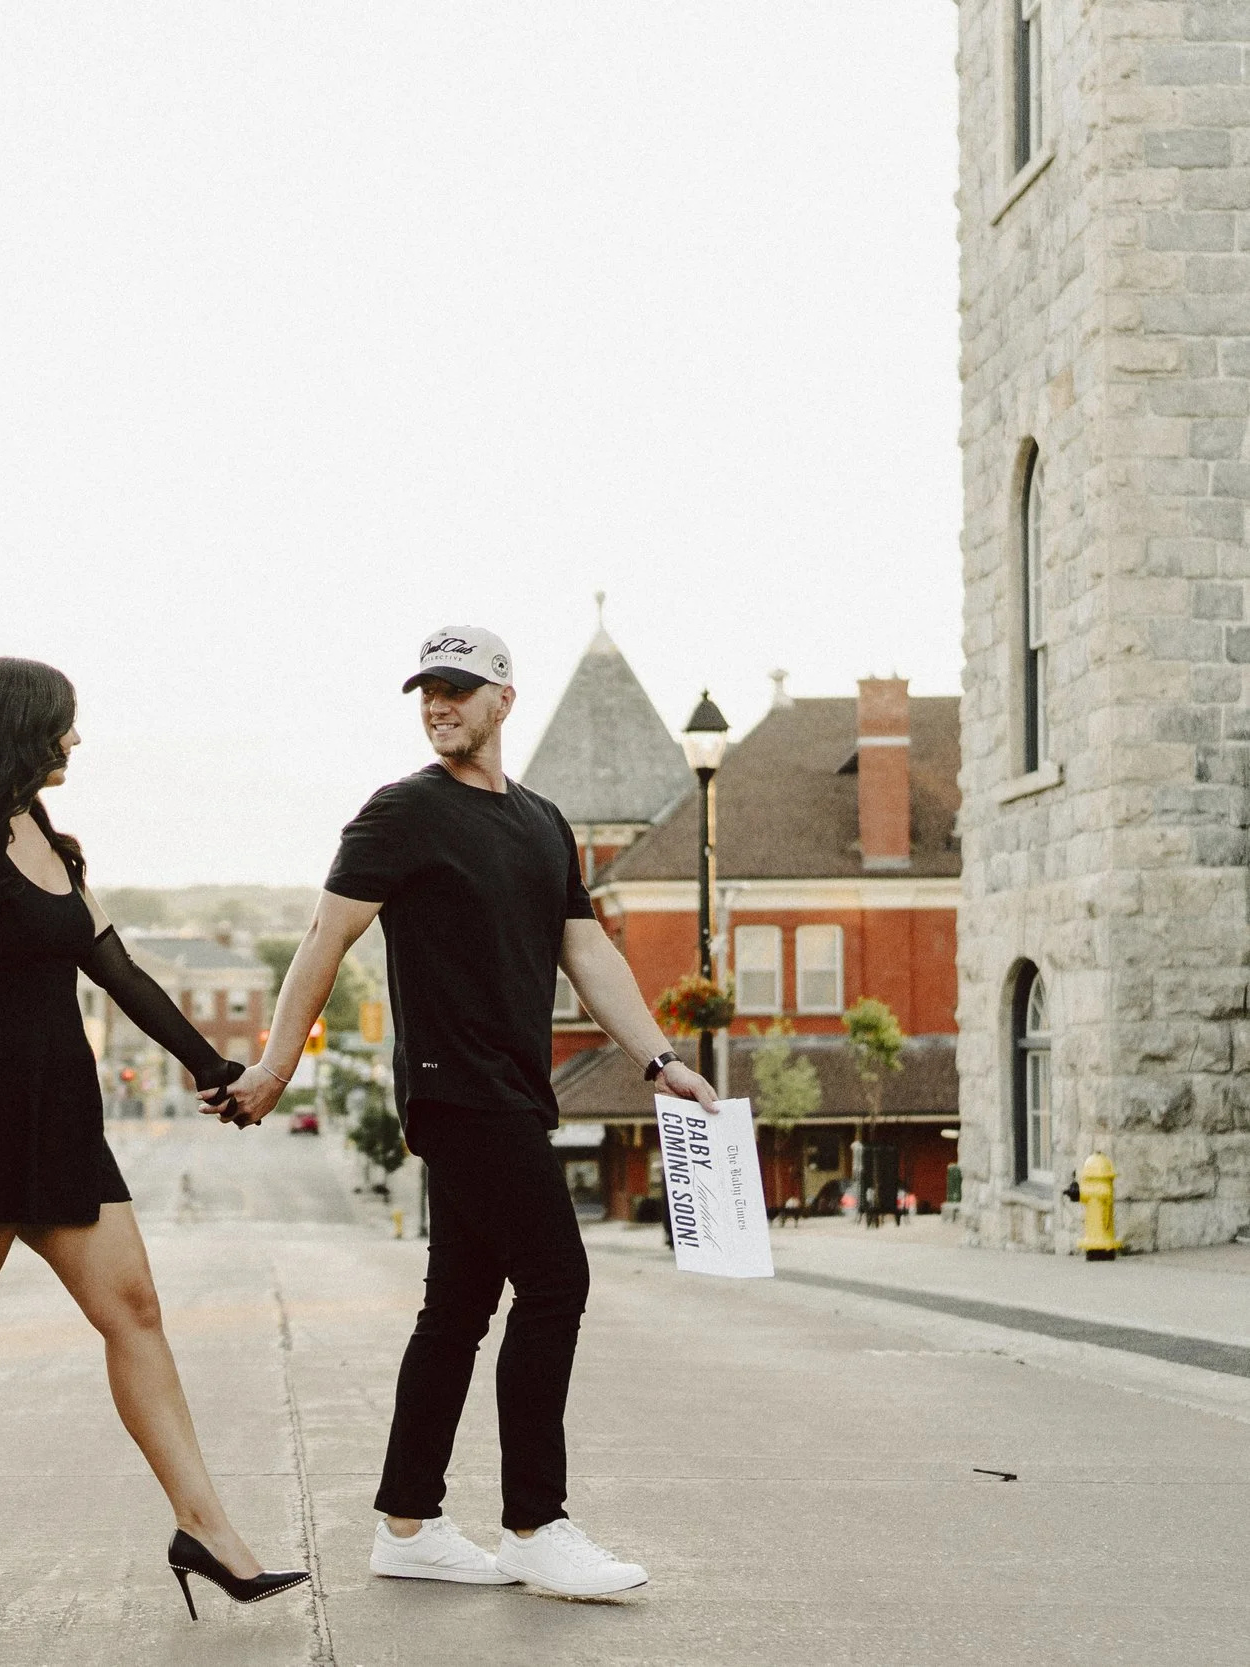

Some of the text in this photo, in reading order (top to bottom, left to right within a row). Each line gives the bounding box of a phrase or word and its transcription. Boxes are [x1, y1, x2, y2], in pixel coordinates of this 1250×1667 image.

[661, 1111, 700, 1249] COMING SOON!
[685, 1116, 713, 1170] BABY
[727, 1144, 739, 1166] The
[734, 1198, 747, 1231] Times
